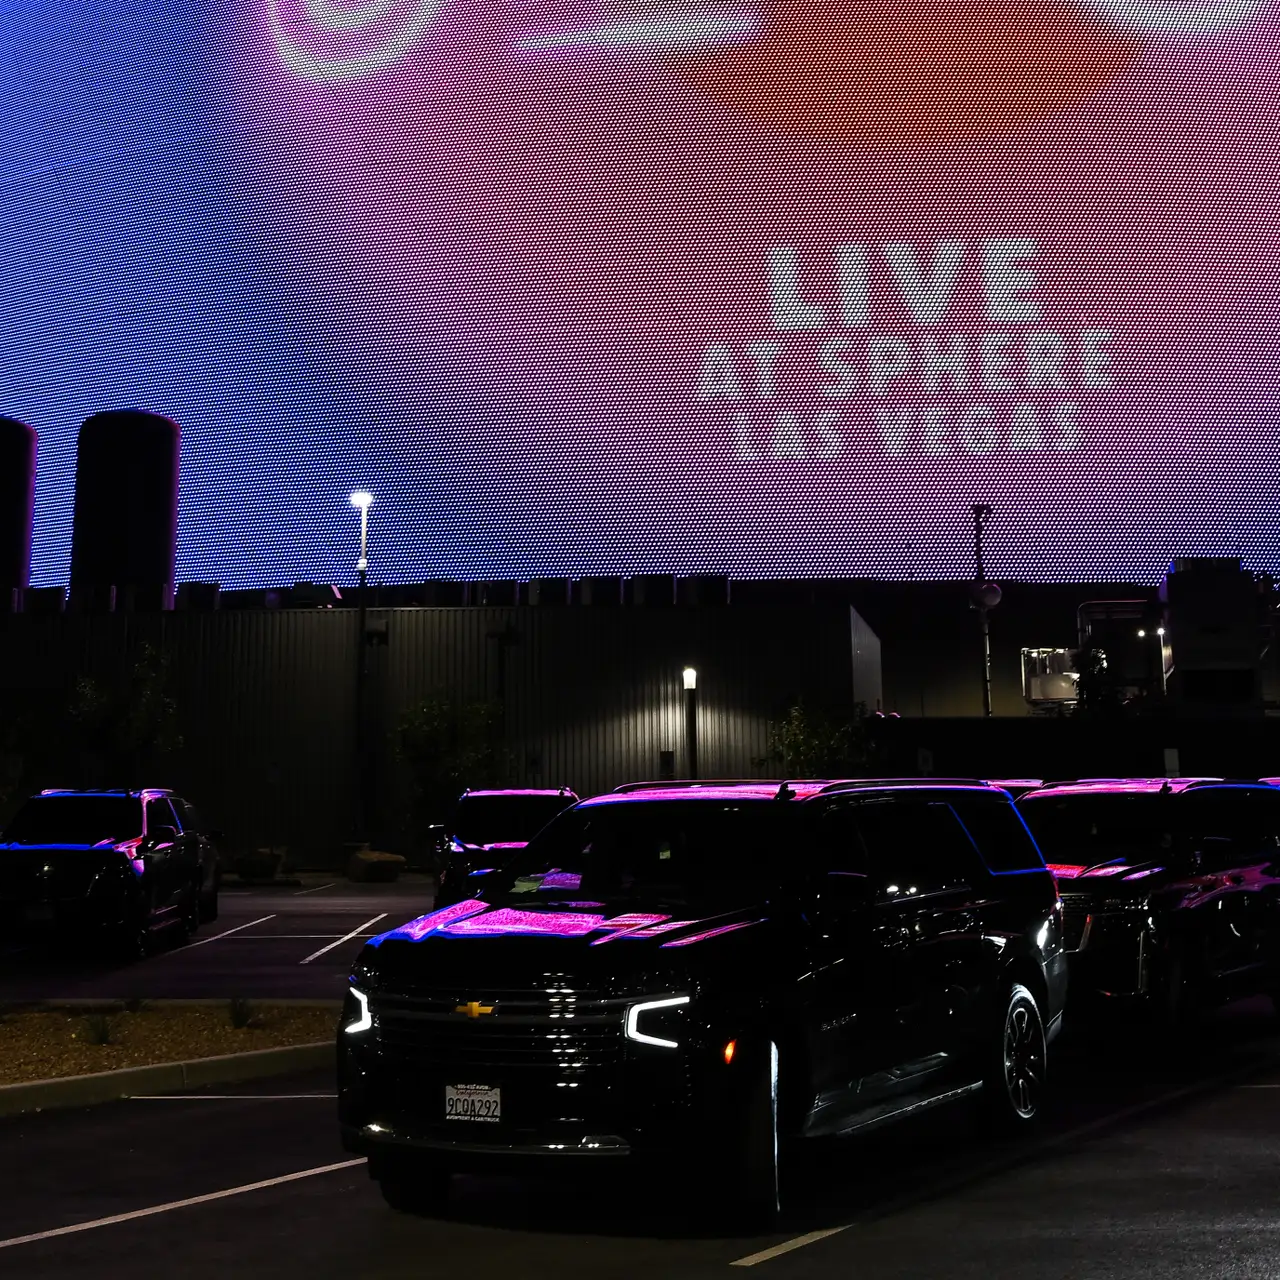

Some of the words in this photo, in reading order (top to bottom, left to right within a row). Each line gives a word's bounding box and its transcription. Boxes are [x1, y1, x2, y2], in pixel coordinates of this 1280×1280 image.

[767, 236, 1042, 331] LIVE
[695, 340, 781, 402] AT
[819, 328, 1117, 400] SPHERE
[732, 408, 845, 463] LAS
[875, 401, 1085, 460] VEGAS
